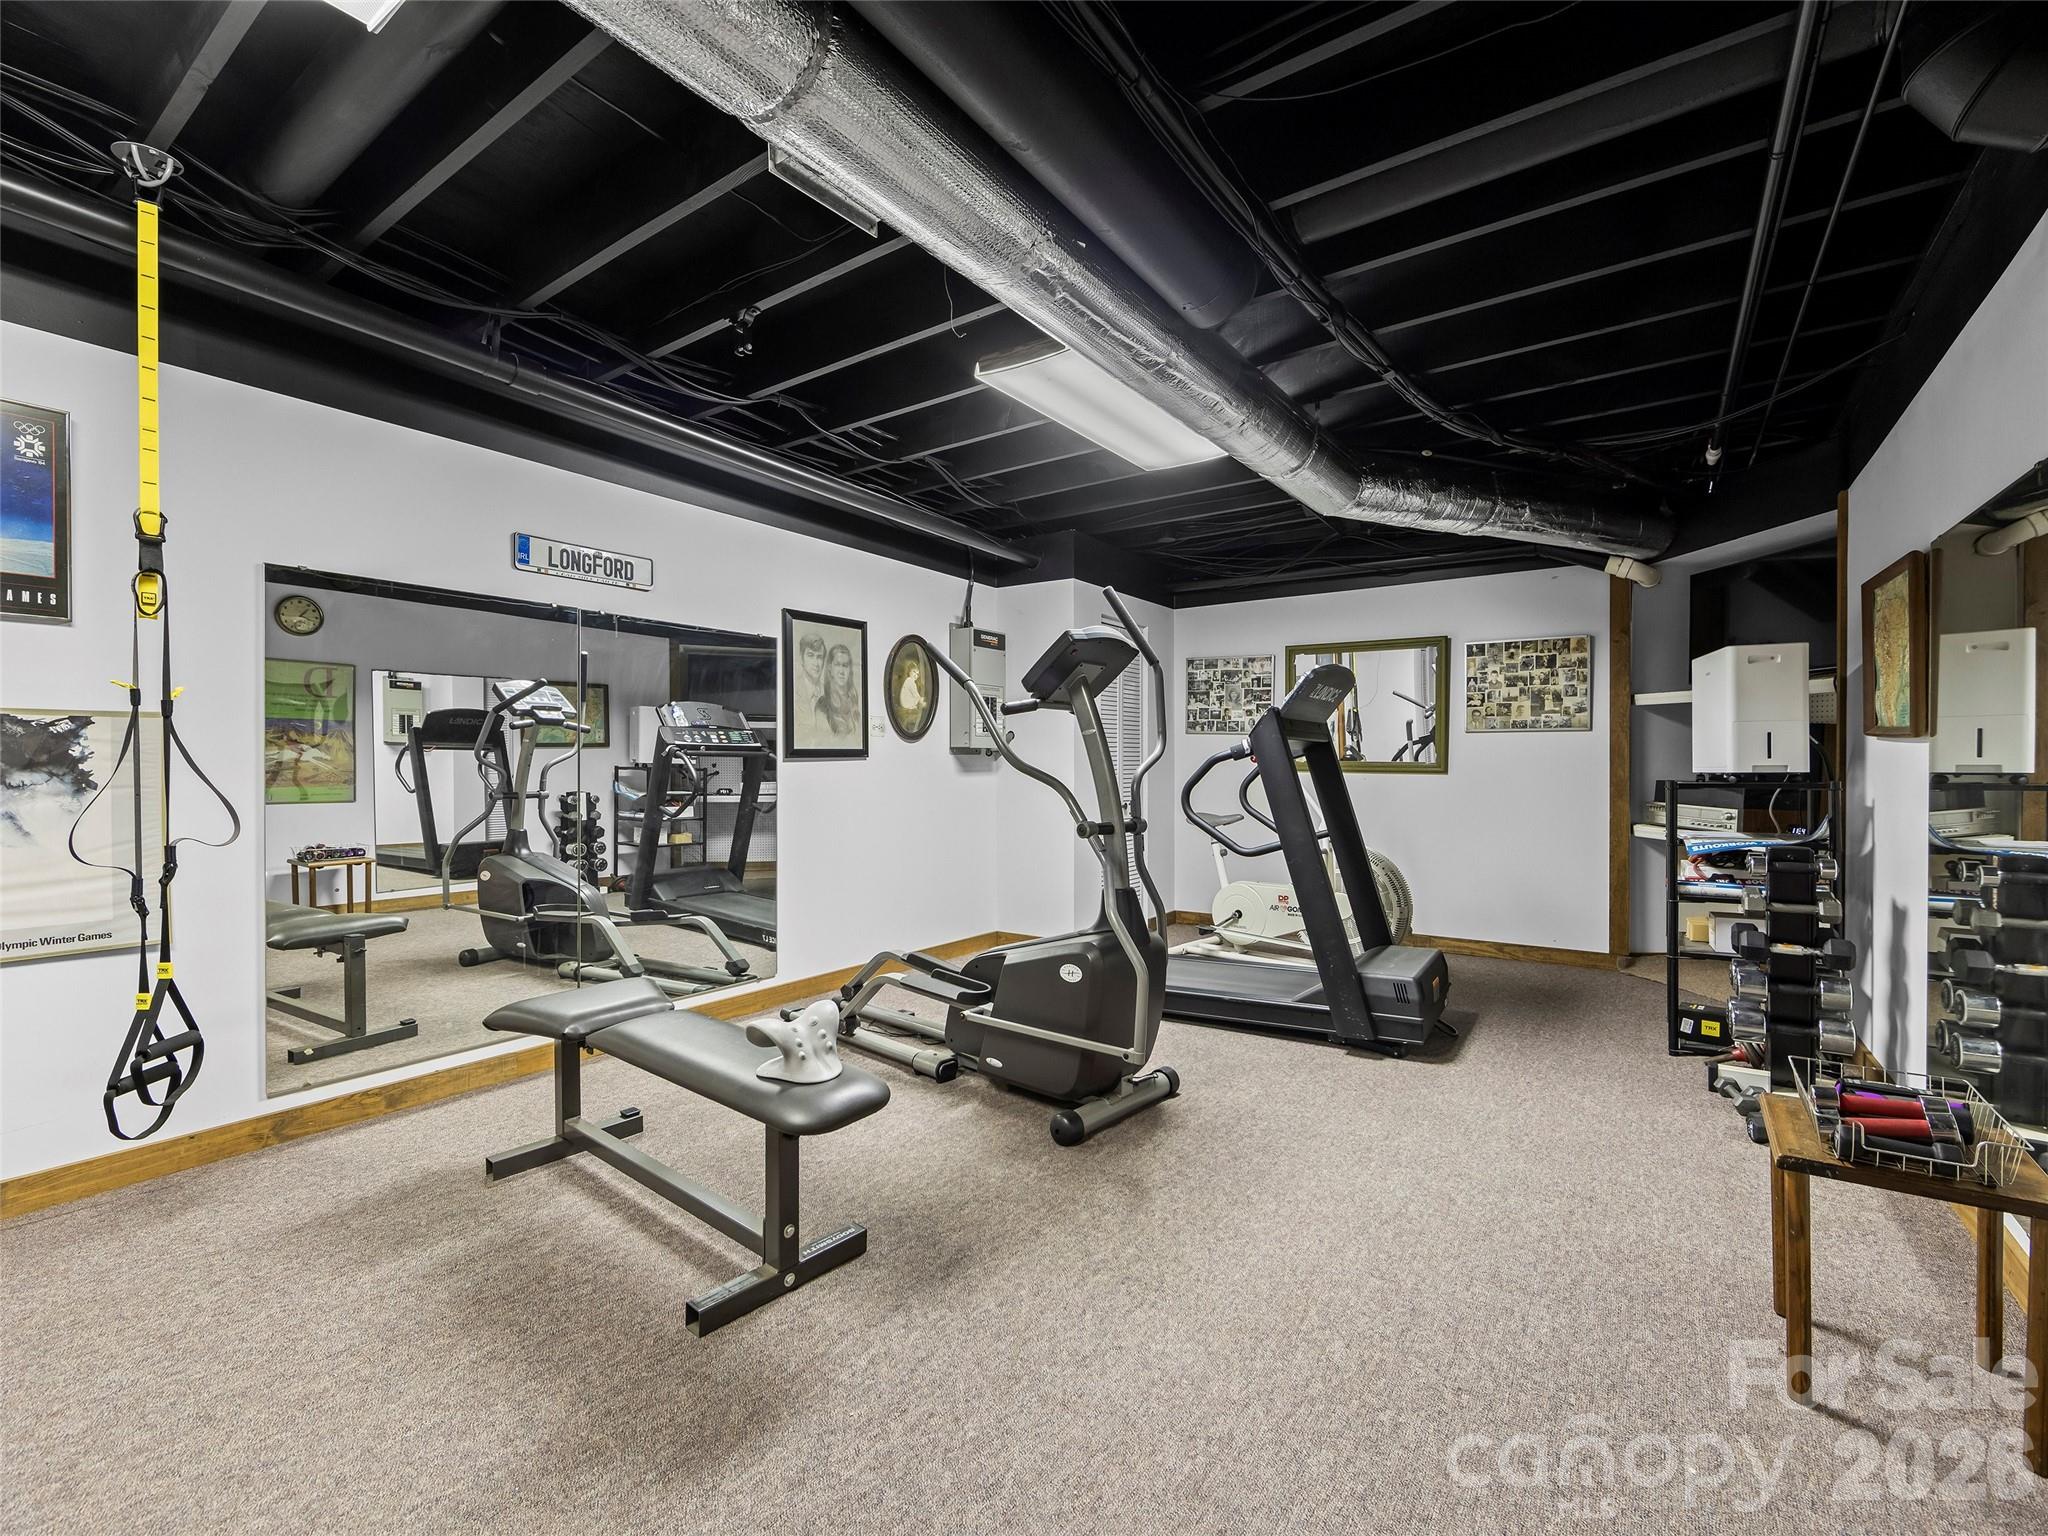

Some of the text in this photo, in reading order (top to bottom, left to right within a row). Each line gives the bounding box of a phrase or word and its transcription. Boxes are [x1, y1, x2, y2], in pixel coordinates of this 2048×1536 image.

[548, 546, 634, 581] LONGFORD
[1691, 841, 1758, 851] WORKOUTS
[0, 931, 113, 952] lympic Winter Games
